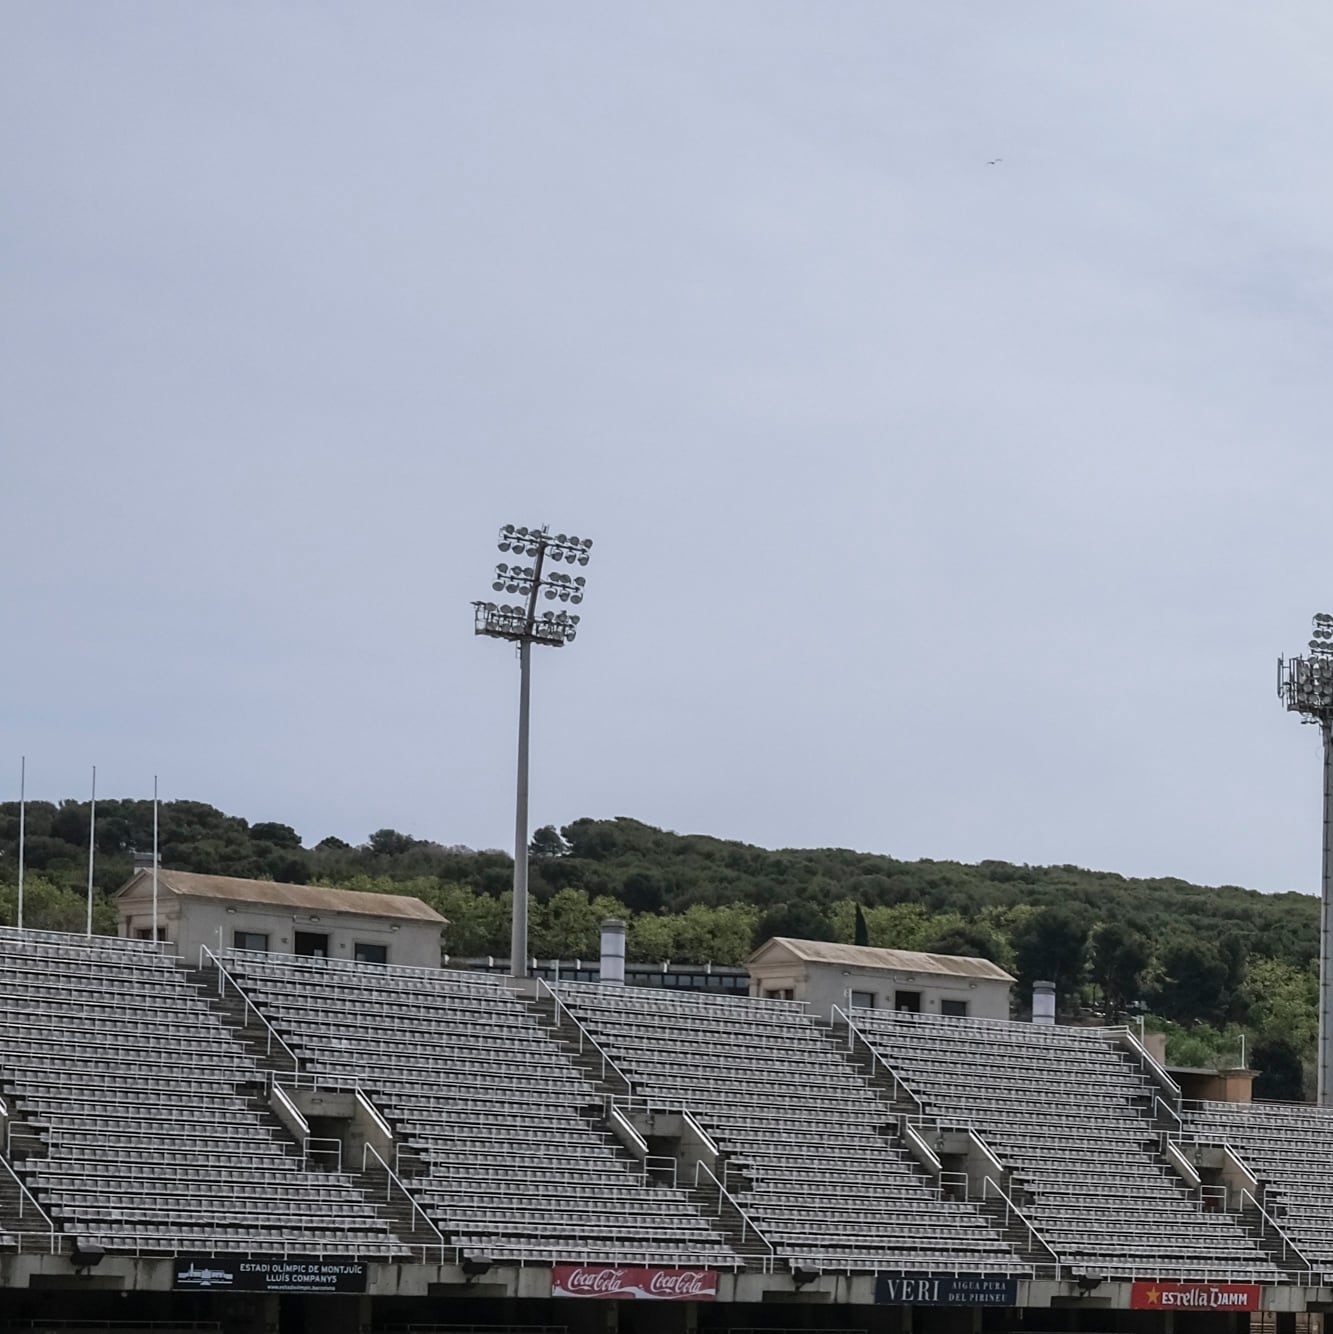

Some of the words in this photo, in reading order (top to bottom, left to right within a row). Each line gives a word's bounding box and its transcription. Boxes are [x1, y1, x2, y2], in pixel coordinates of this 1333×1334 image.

[240, 1263, 270, 1273] ESTADI
[271, 1263, 306, 1273] OLÍMPIC
[308, 1265, 320, 1273] DE
[321, 1264, 362, 1274] MONTJUÏC
[266, 1273, 290, 1282] LLUÍS
[291, 1274, 337, 1283] COMPANYS
[888, 1279, 940, 1301] VERI
[952, 1281, 980, 1290] AIGUA
[983, 1282, 1006, 1290] PURA
[949, 1293, 966, 1301] DEL
[969, 1293, 1006, 1302] PIRINEU
